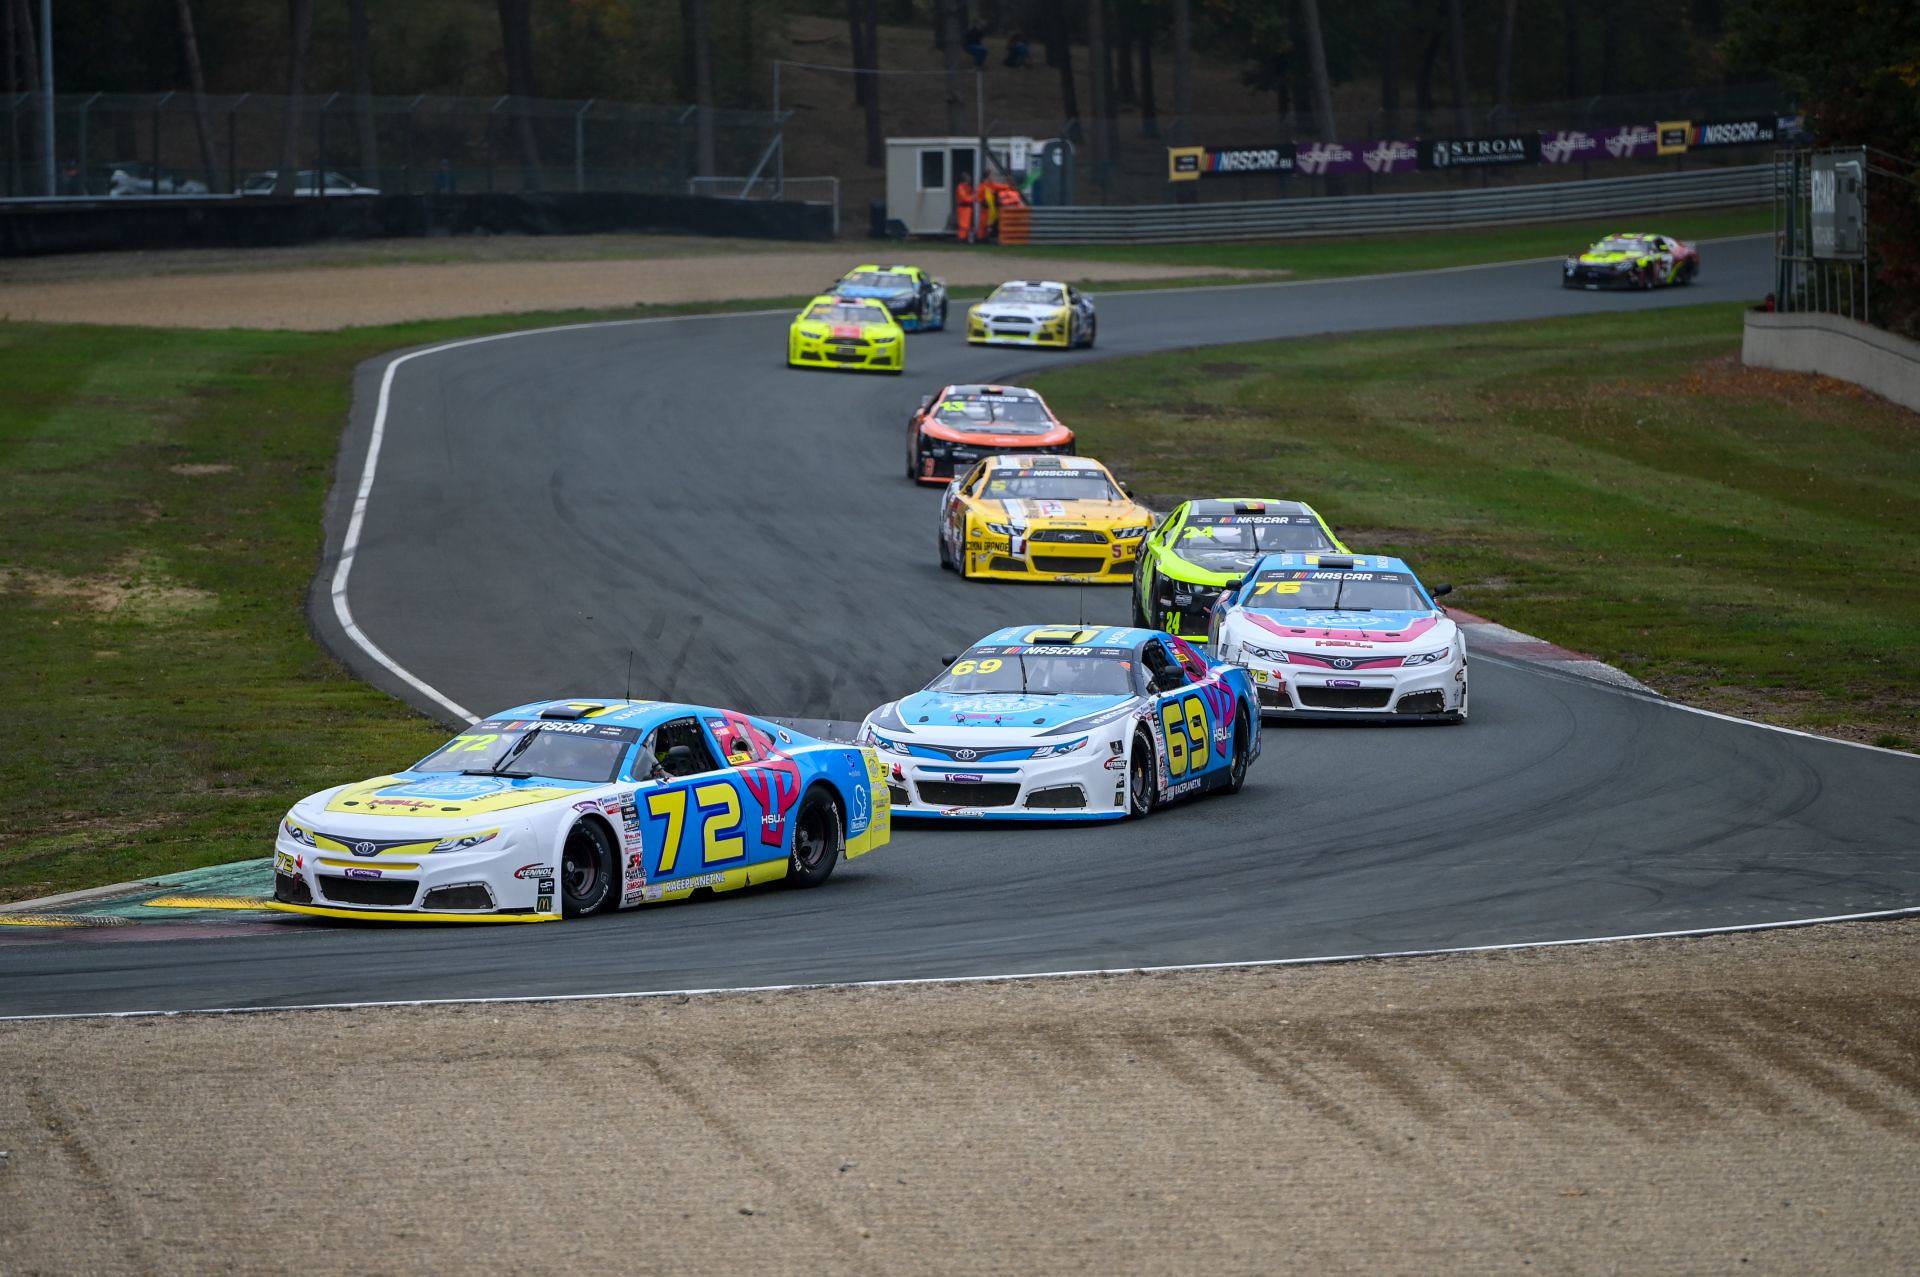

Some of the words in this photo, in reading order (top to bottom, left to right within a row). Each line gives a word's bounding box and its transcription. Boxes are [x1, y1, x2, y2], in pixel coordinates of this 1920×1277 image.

[1451, 138, 1525, 156] STROM
[991, 481, 1006, 492] 5
[1236, 516, 1288, 524] NASCAR
[1183, 526, 1215, 539] 24
[1112, 544, 1123, 559] 5
[1312, 572, 1372, 583] NASCAR
[1255, 582, 1301, 595] 76
[1166, 612, 1181, 635] 24
[1024, 647, 1092, 657] NASCAR
[951, 659, 1003, 676] 69
[523, 720, 595, 735] NASCAR
[446, 734, 499, 753] 72
[1162, 696, 1209, 778] 69
[646, 782, 745, 874] 72
[275, 851, 295, 873] 72
